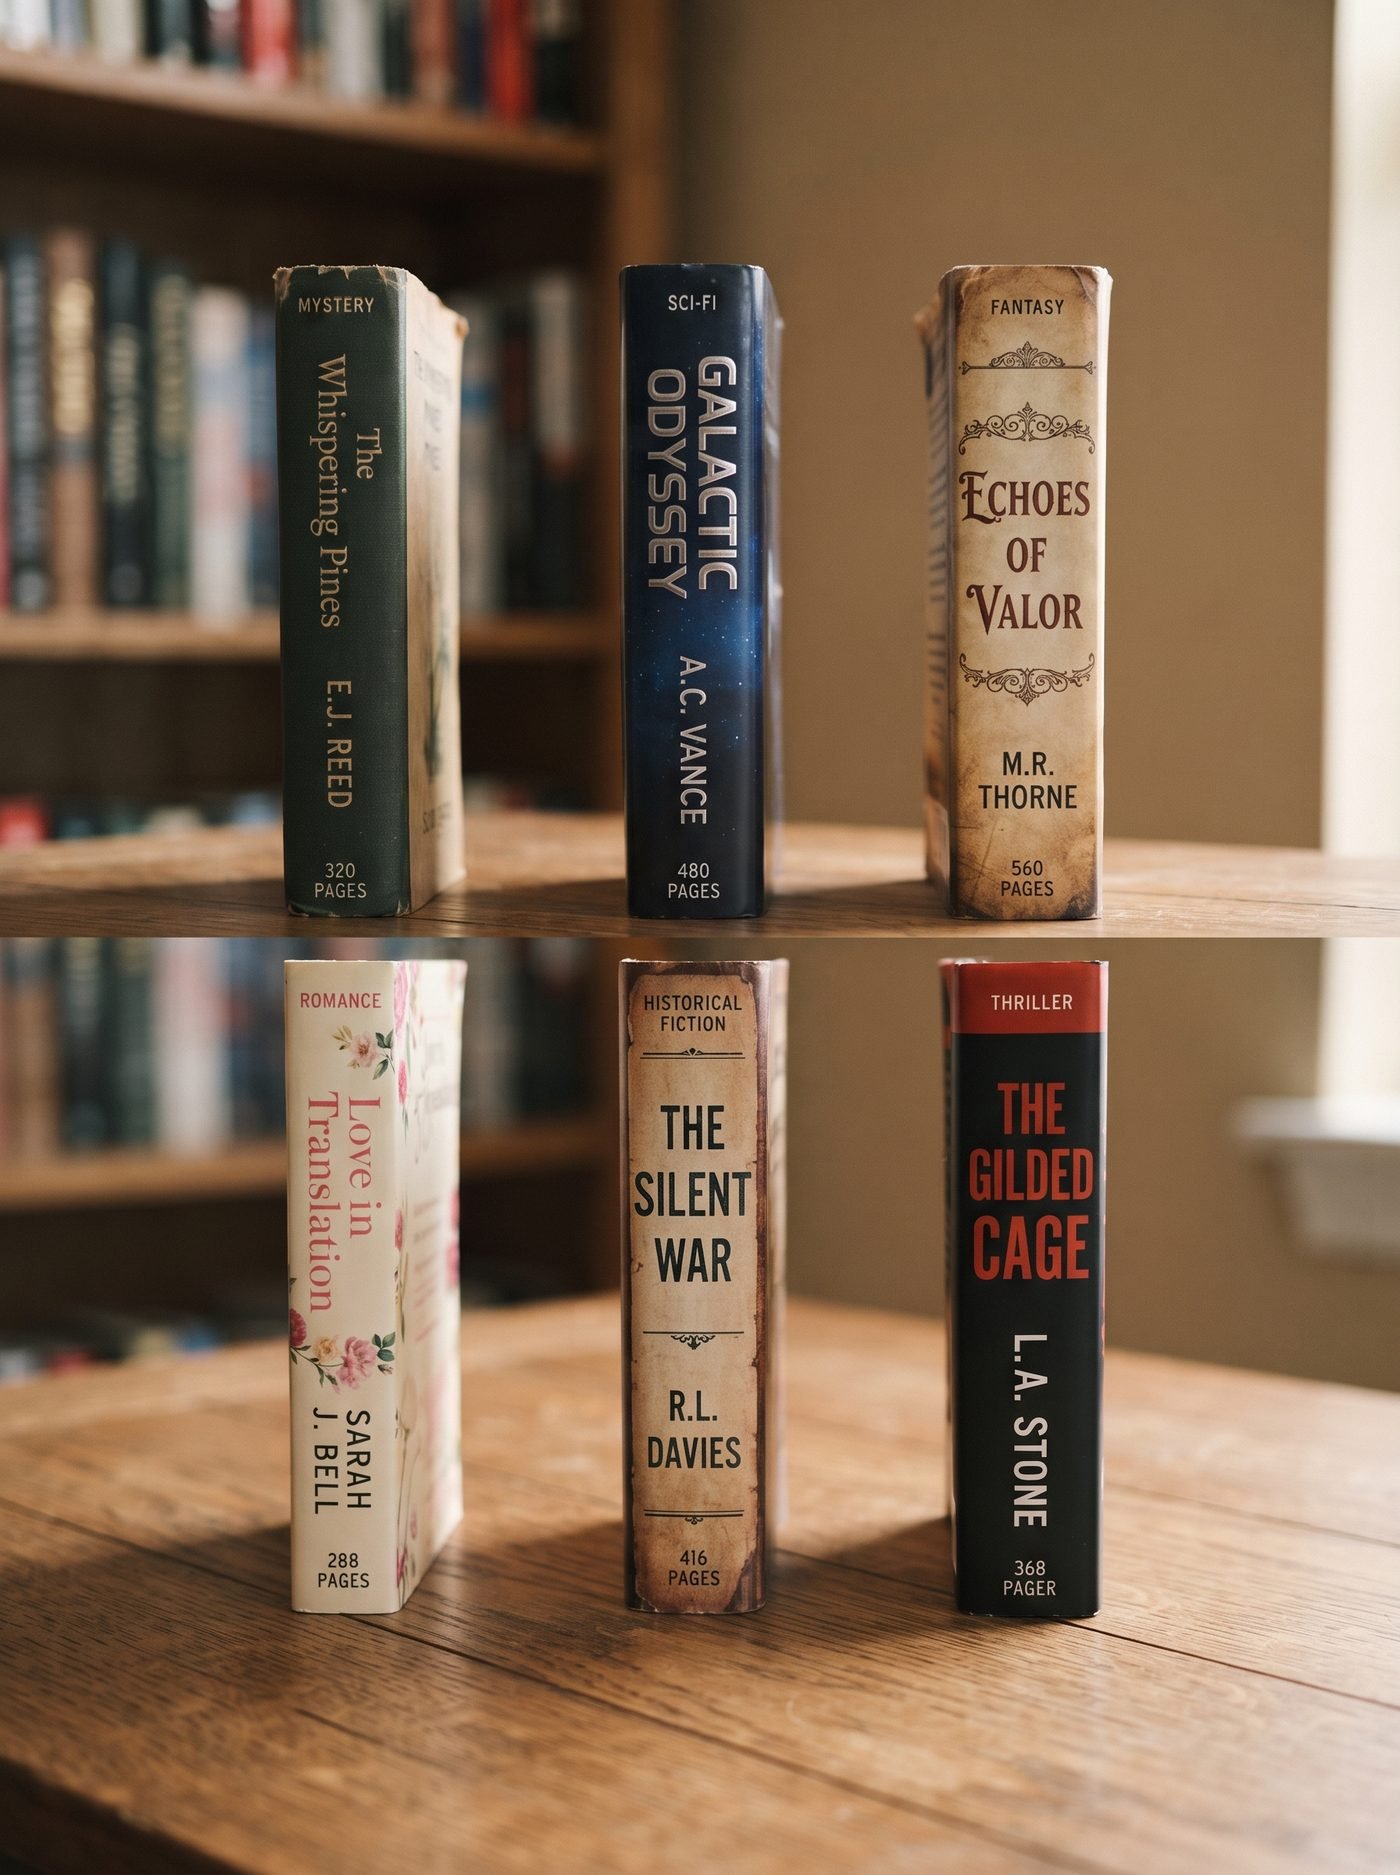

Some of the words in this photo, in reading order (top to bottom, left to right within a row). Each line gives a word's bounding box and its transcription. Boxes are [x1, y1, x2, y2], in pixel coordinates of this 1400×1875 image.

[299, 297, 374, 313] MYSTERY
[668, 294, 717, 311] SCI-FI
[991, 299, 1064, 315] FANTASY
[310, 353, 348, 537] Whispering
[356, 428, 384, 480] The
[647, 368, 687, 600] ODYSSEY
[697, 355, 738, 592] GALACTIC
[1006, 537, 1047, 573] OF
[319, 545, 348, 628] Pines
[679, 655, 707, 714] A.C.
[326, 680, 353, 728] E.J.
[327, 739, 353, 808] REED
[680, 723, 707, 825] VANCE
[1002, 751, 1055, 776] M.R.
[978, 784, 1078, 809] THORNE
[325, 862, 356, 879] 320
[677, 862, 710, 879] 480
[1011, 860, 1044, 876] 560
[314, 883, 367, 899] PAGES
[668, 883, 720, 899] PAGES
[1001, 880, 1054, 897] PAGES
[300, 992, 382, 1009] ROMANCE
[644, 995, 742, 1011] HISTORICAL
[991, 994, 1073, 1011] THRILLER
[661, 1015, 726, 1032] FICTION
[997, 1082, 1065, 1135] THE
[348, 1095, 381, 1189] Love
[660, 1104, 725, 1150] THE
[969, 1148, 1094, 1201] GILDED
[307, 1090, 342, 1313] Translation
[634, 1171, 752, 1218] SILENT
[349, 1201, 382, 1239] in
[654, 1237, 732, 1283] WAR
[973, 1214, 1090, 1281] CAGE
[1013, 1334, 1048, 1401] L.A.
[313, 1407, 339, 1430] J.
[669, 1390, 718, 1422] R.L.
[346, 1410, 372, 1509] SARAH
[647, 1436, 741, 1469] DAVIES
[314, 1445, 339, 1515] BELL
[1013, 1416, 1049, 1527] STONE
[327, 1553, 359, 1569] 288
[679, 1550, 708, 1566] 416
[1014, 1560, 1046, 1576] 368
[318, 1573, 370, 1588] PAGES
[668, 1570, 720, 1586] PAGES
[1003, 1580, 1056, 1596] PAGER
